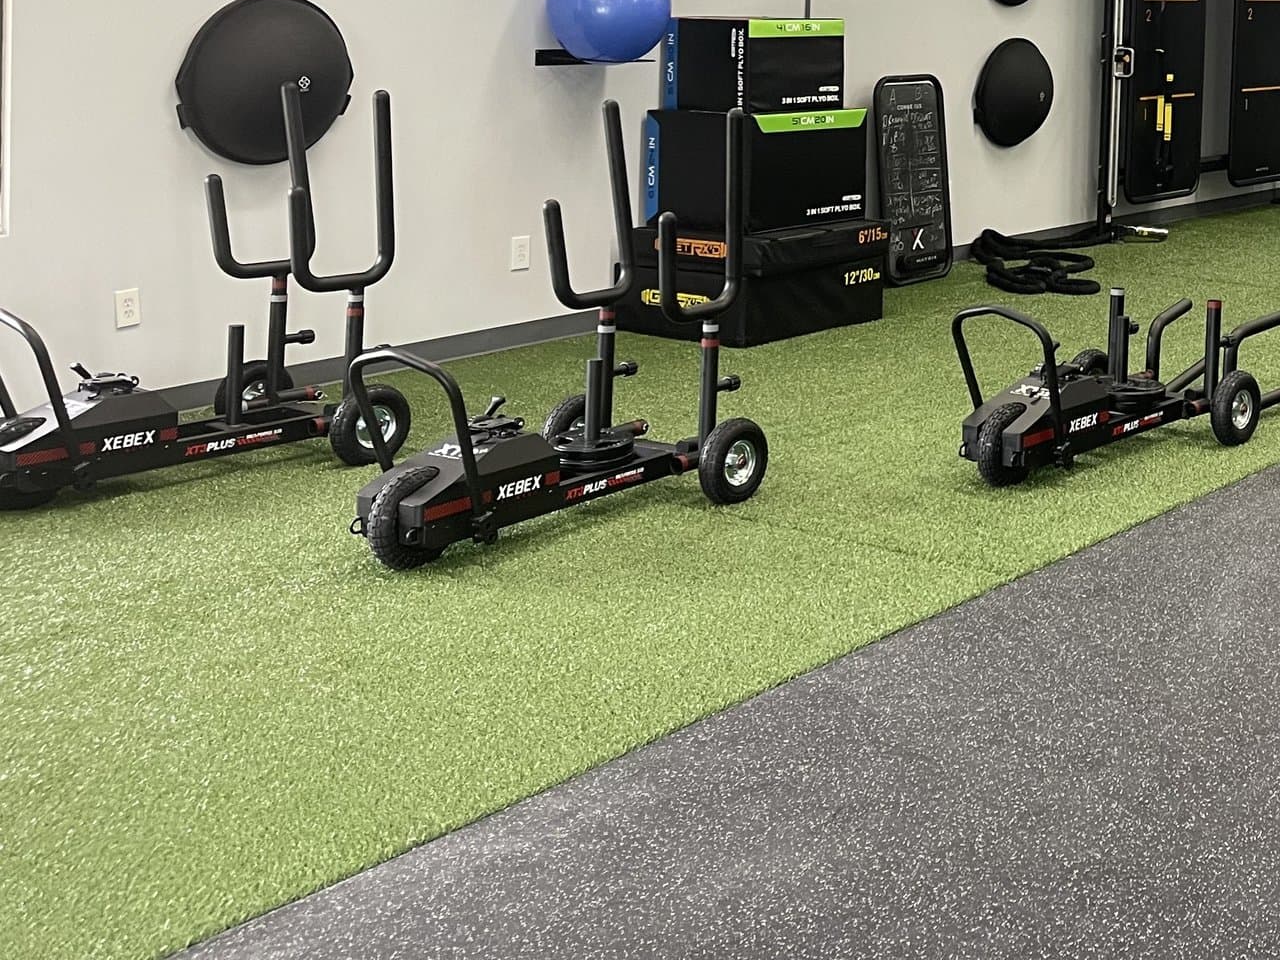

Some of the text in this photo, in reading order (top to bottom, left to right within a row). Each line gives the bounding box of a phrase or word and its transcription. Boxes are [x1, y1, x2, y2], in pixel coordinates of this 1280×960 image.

[737, 47, 745, 70] PLYO
[1069, 412, 1099, 434] XEBEX
[101, 429, 156, 453] XEBEX
[496, 474, 543, 501] XEBEX
